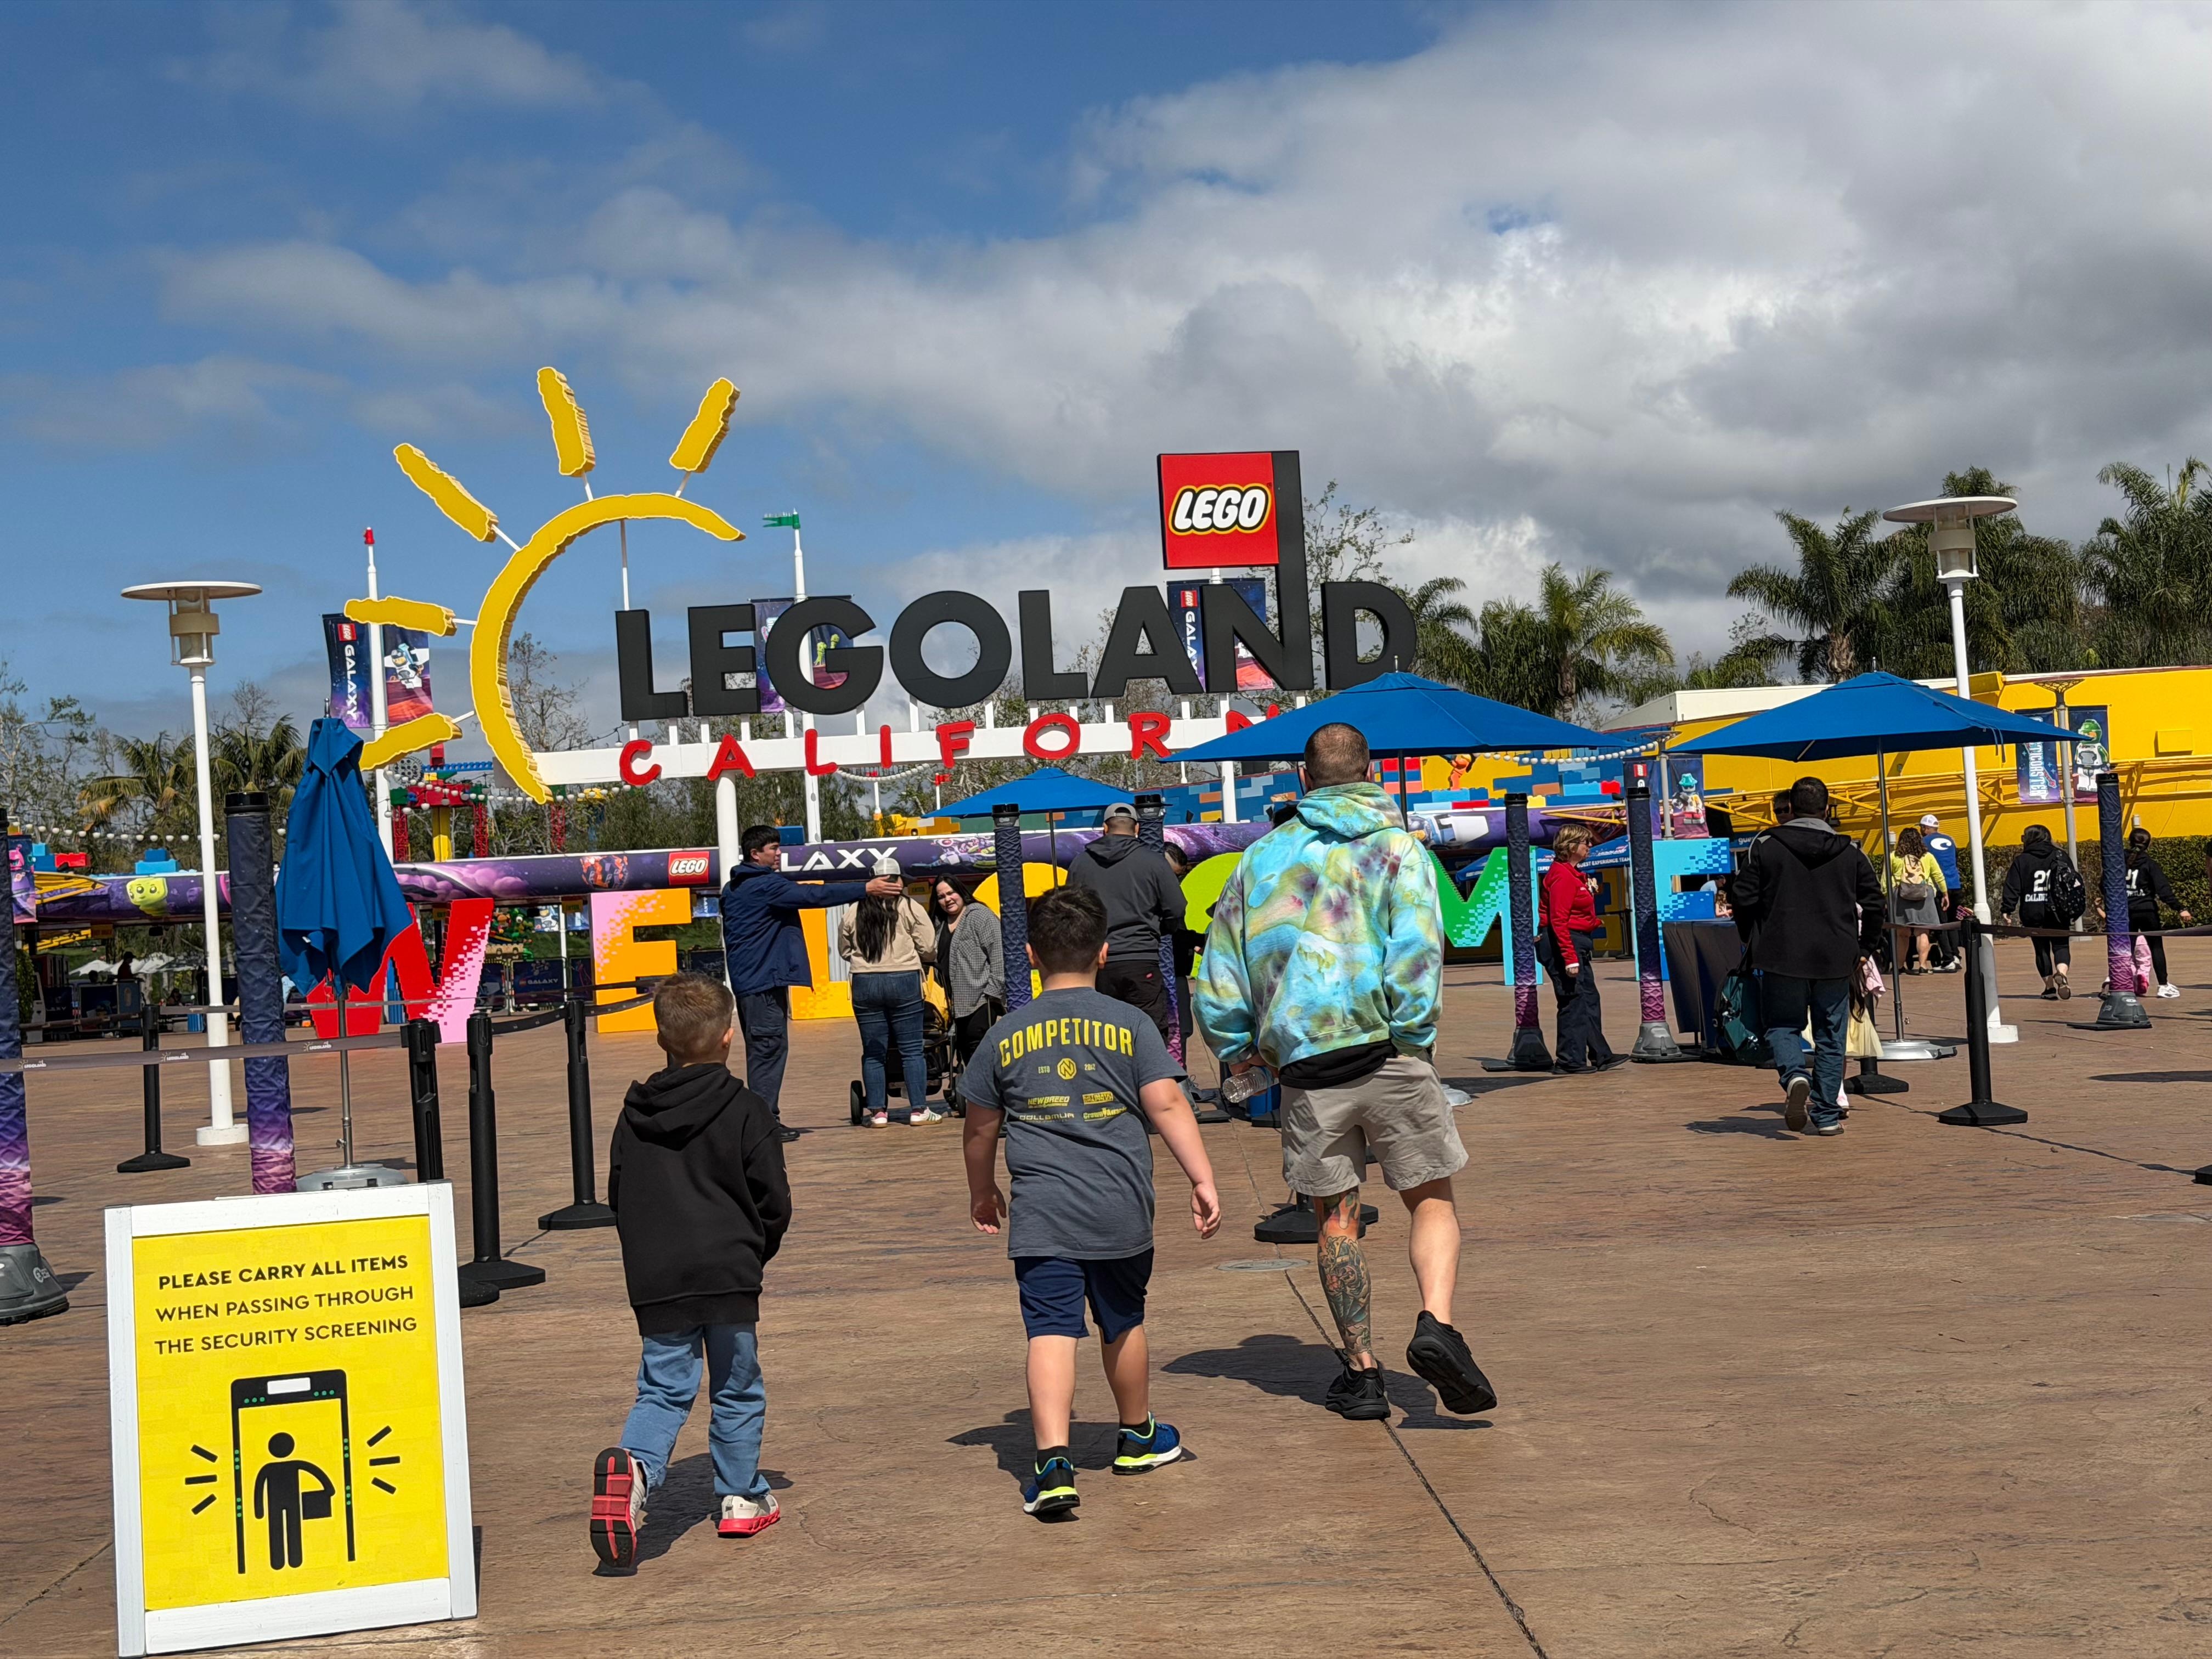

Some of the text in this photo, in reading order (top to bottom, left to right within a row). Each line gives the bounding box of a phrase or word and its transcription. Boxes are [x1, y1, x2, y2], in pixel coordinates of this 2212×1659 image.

[1173, 488, 1267, 531] LEGO
[345, 644, 358, 721] GALAXY
[670, 847, 898, 875] LEGO LAXY
[1592, 857, 1618, 866] EXPERIENCE
[998, 1018, 1133, 1068] COMPETITOR
[159, 1254, 408, 1290] PLEASE CARRY ALL ITEMS
[155, 1285, 414, 1322] WHEN PASSING THROUGH
[154, 1317, 417, 1355] THE SECURITY SCREENING
